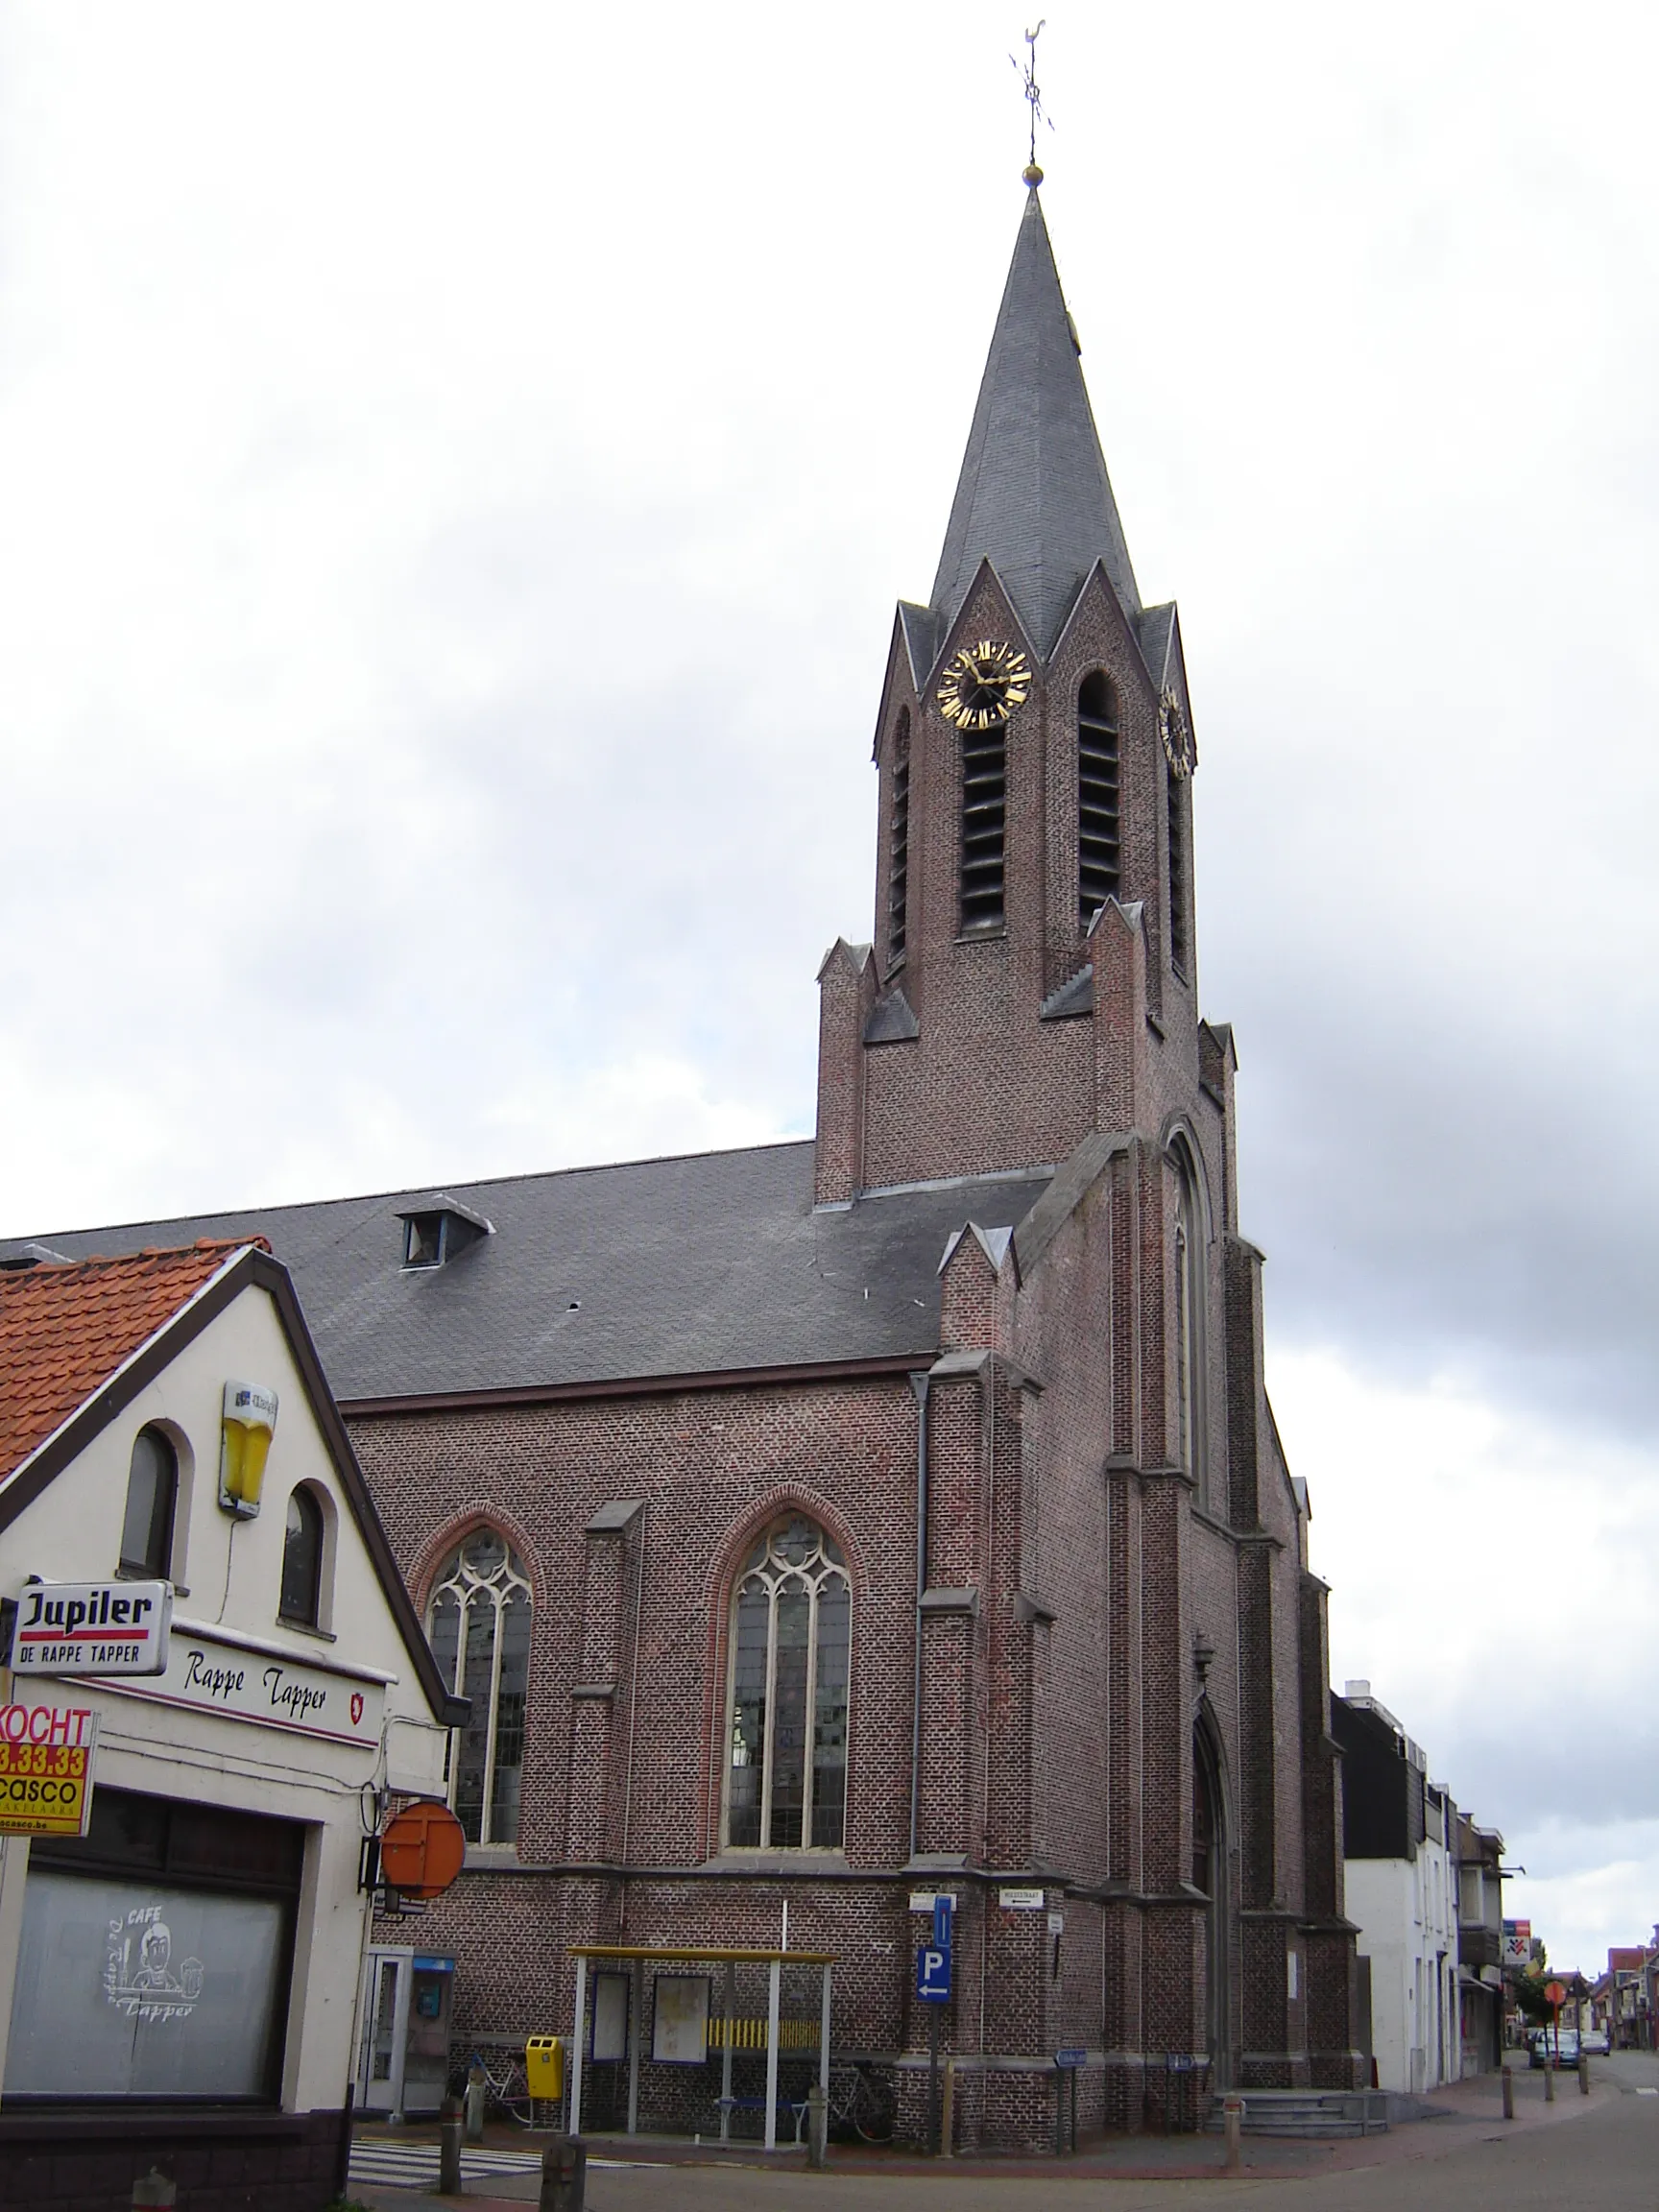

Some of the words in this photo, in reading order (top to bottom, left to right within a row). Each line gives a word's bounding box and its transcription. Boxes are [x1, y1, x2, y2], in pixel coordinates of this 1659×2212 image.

[23, 1590, 152, 1635] Jupiler
[20, 1647, 36, 1663] DE
[41, 1646, 83, 1663] RAPPE
[91, 1646, 140, 1663] TAPPER
[184, 1650, 244, 1699] Rappe
[262, 1667, 326, 1719] Tapper
[128, 1906, 162, 1925] CAFE
[924, 1952, 944, 1980] P
[116, 1997, 194, 2023] Tapper
